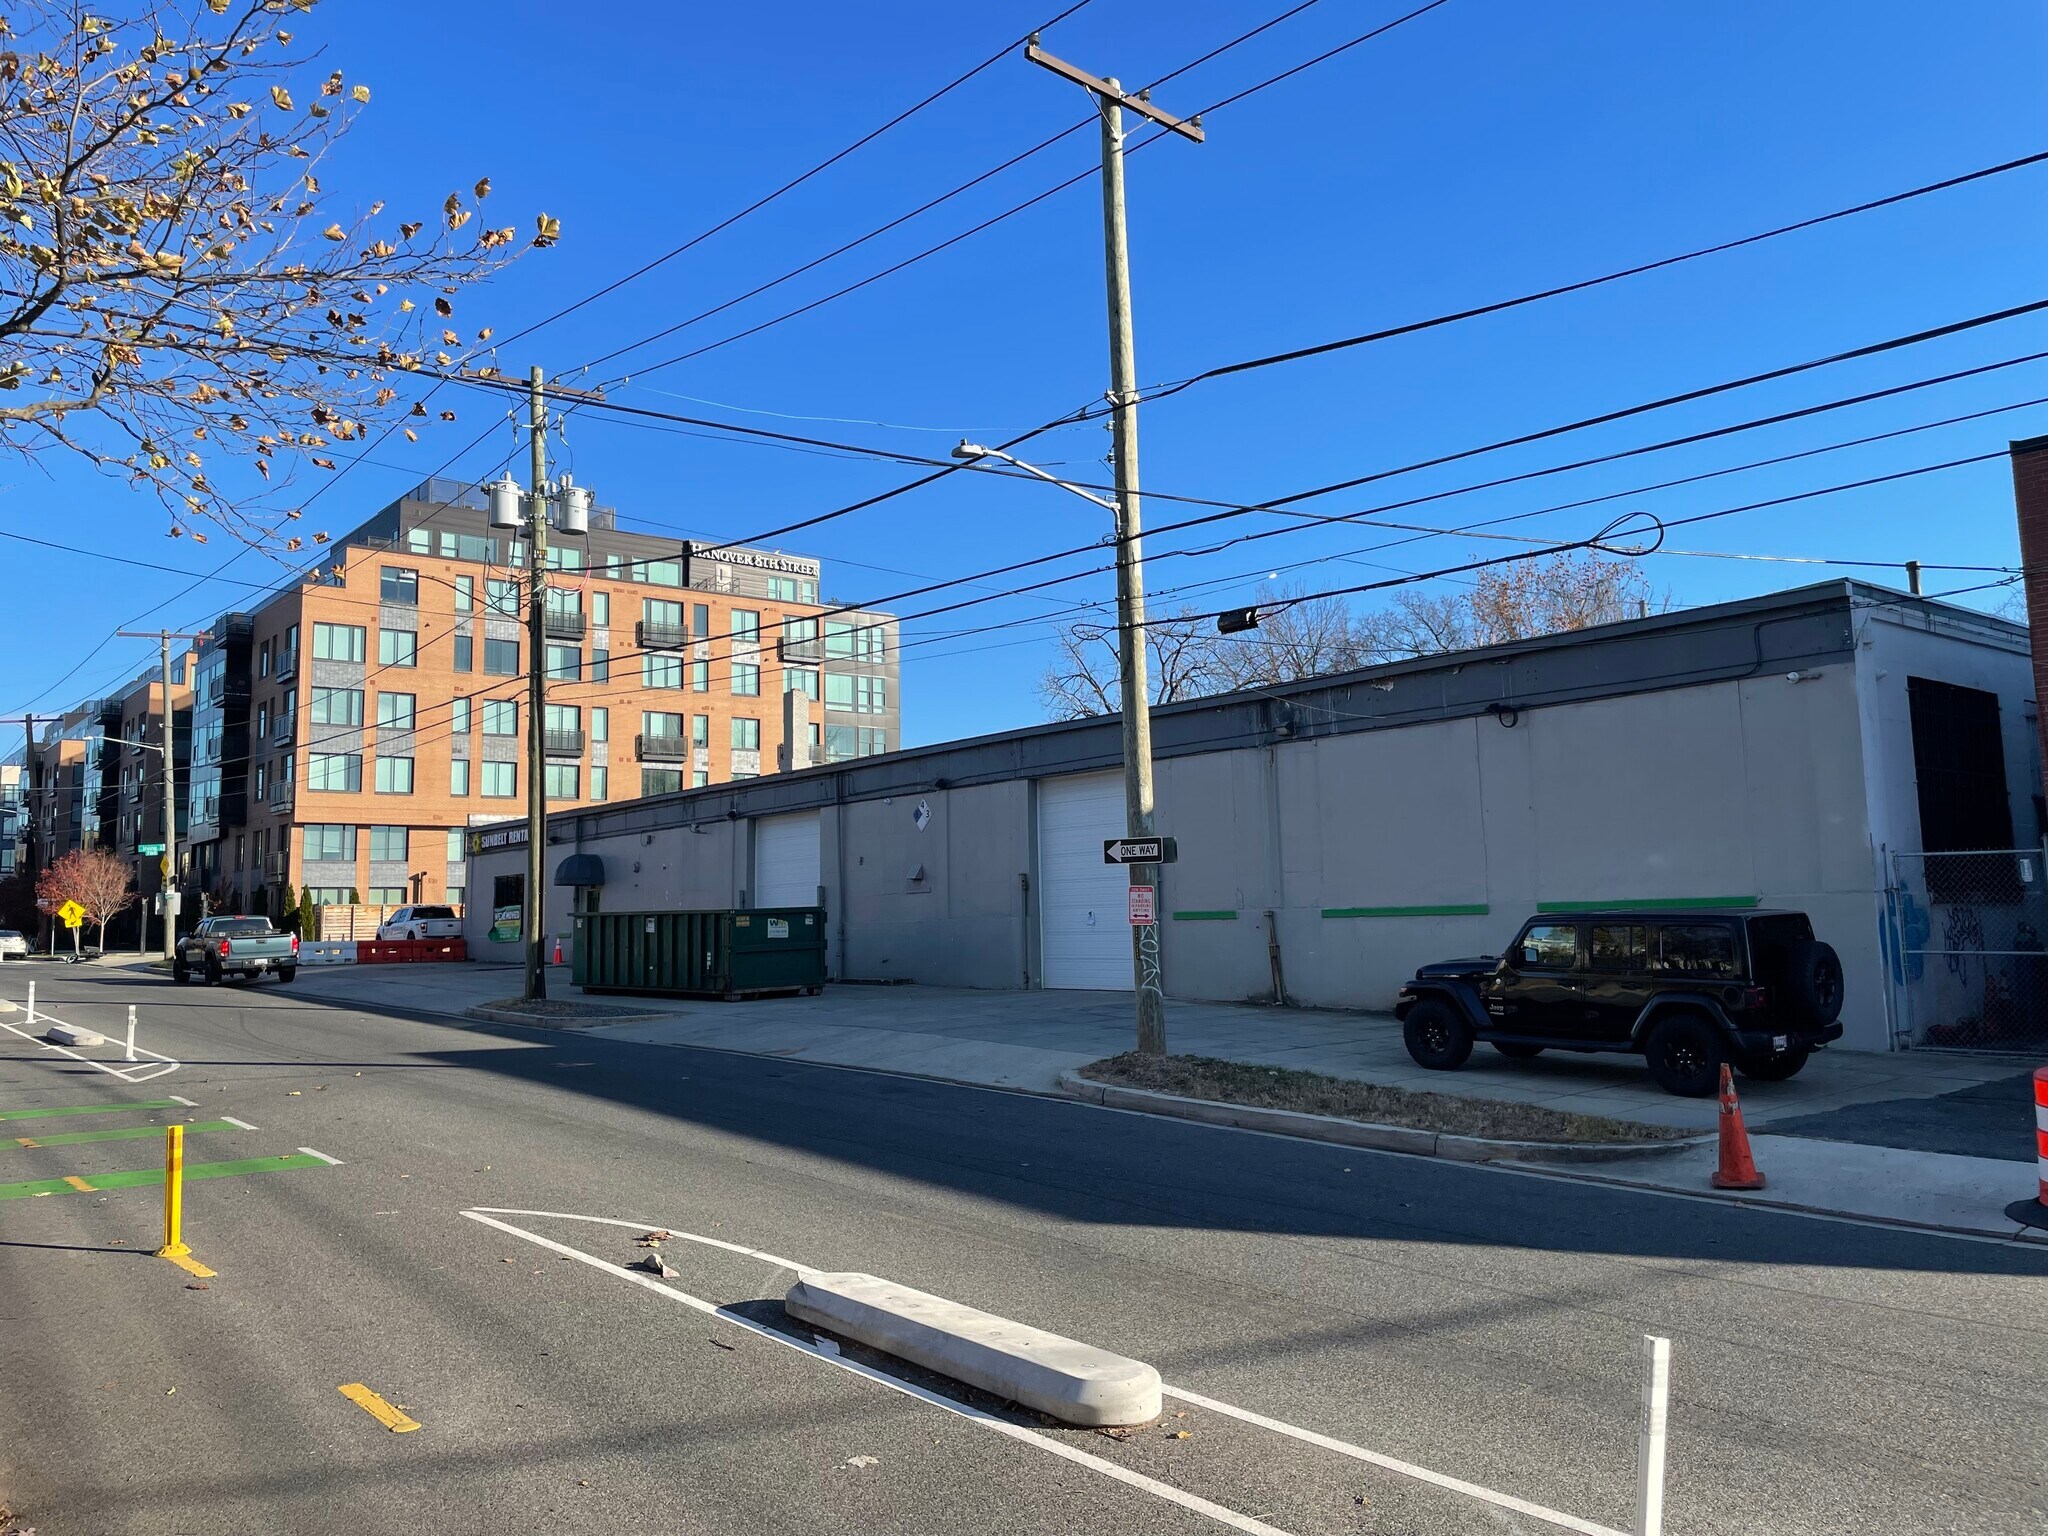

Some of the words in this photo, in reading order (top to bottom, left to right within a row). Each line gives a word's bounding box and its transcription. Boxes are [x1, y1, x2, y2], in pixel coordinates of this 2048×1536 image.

[692, 543, 752, 566] HANOVER
[755, 555, 779, 570] 8TH
[781, 559, 819, 576] STREET
[482, 833, 507, 848] SUNBELT
[508, 829, 529, 843] RENTA
[1121, 846, 1137, 856] ONE
[1138, 845, 1155, 855] WAY
[1489, 1003, 1504, 1012] Jeep
